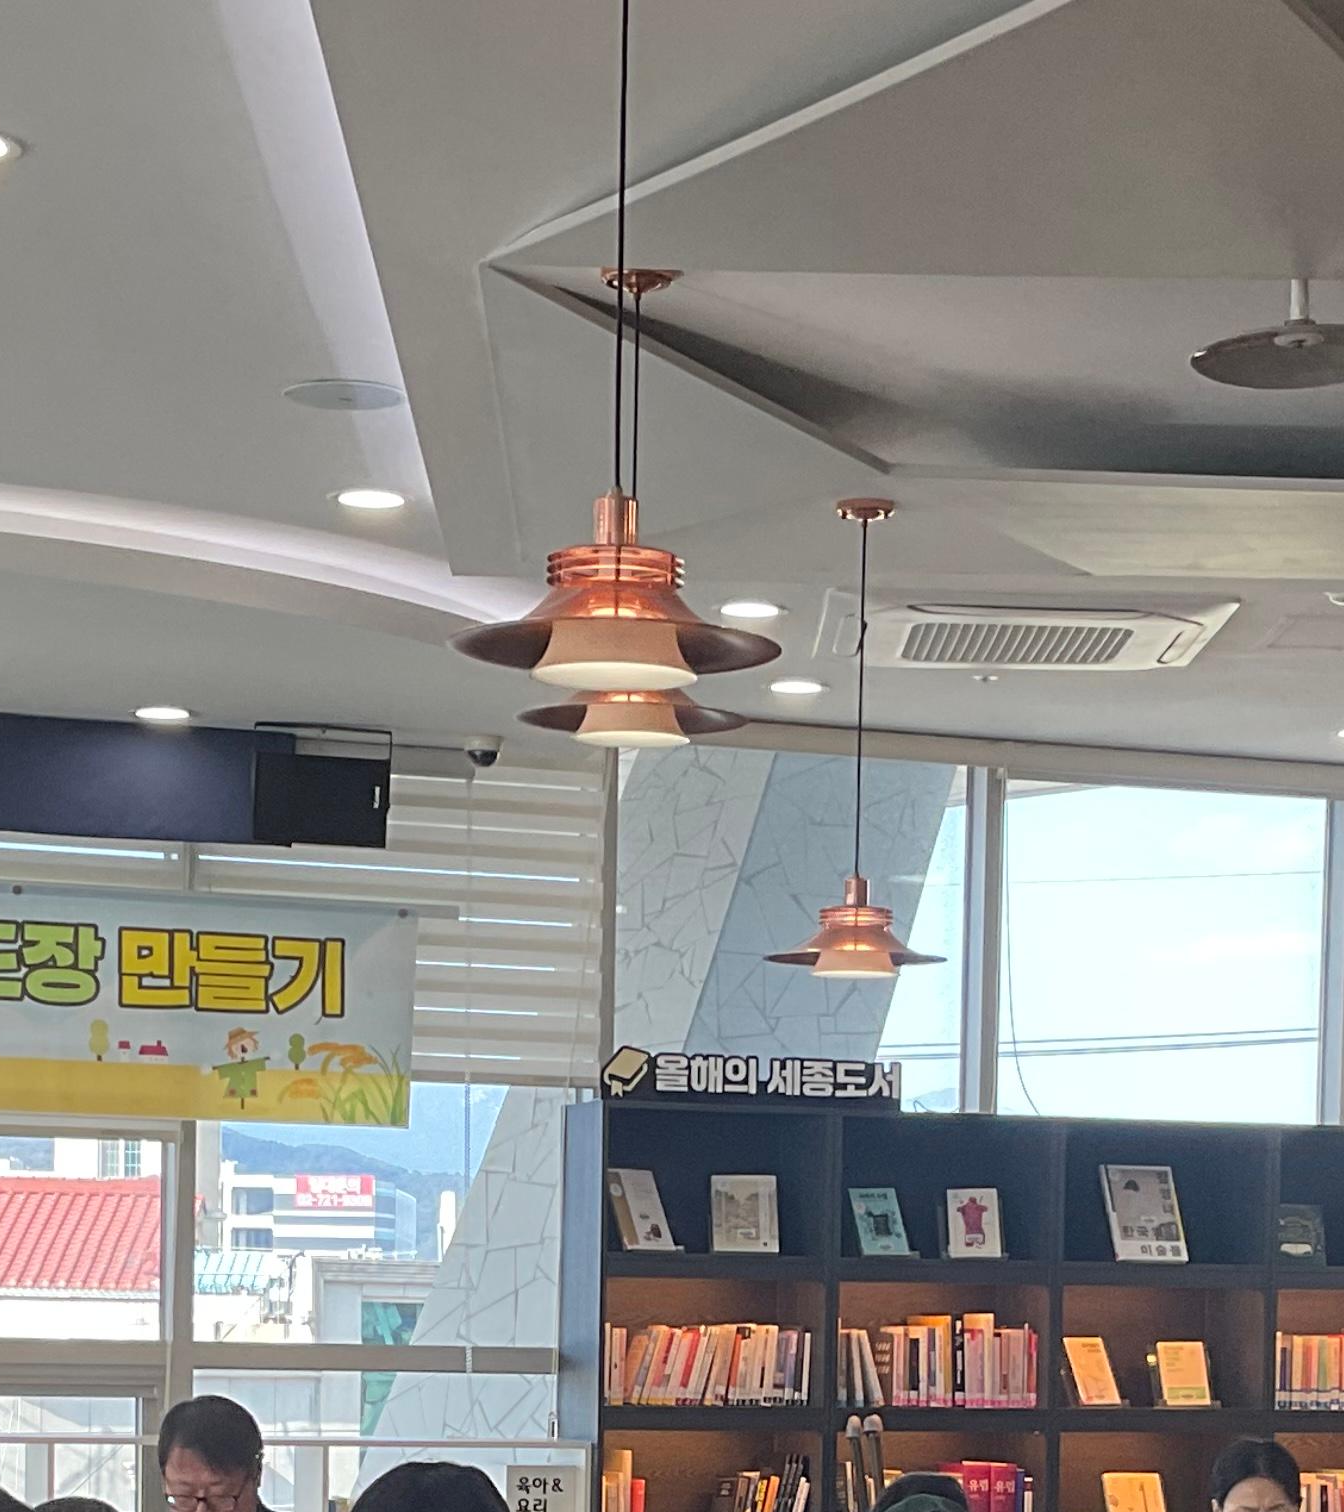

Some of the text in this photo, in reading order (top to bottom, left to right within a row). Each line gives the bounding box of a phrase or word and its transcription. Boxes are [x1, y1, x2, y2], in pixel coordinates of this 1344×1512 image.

[118, 926, 346, 1018] 만들기
[655, 1052, 902, 1100] 올해의 세종도서
[516, 1477, 547, 1495] 육아
